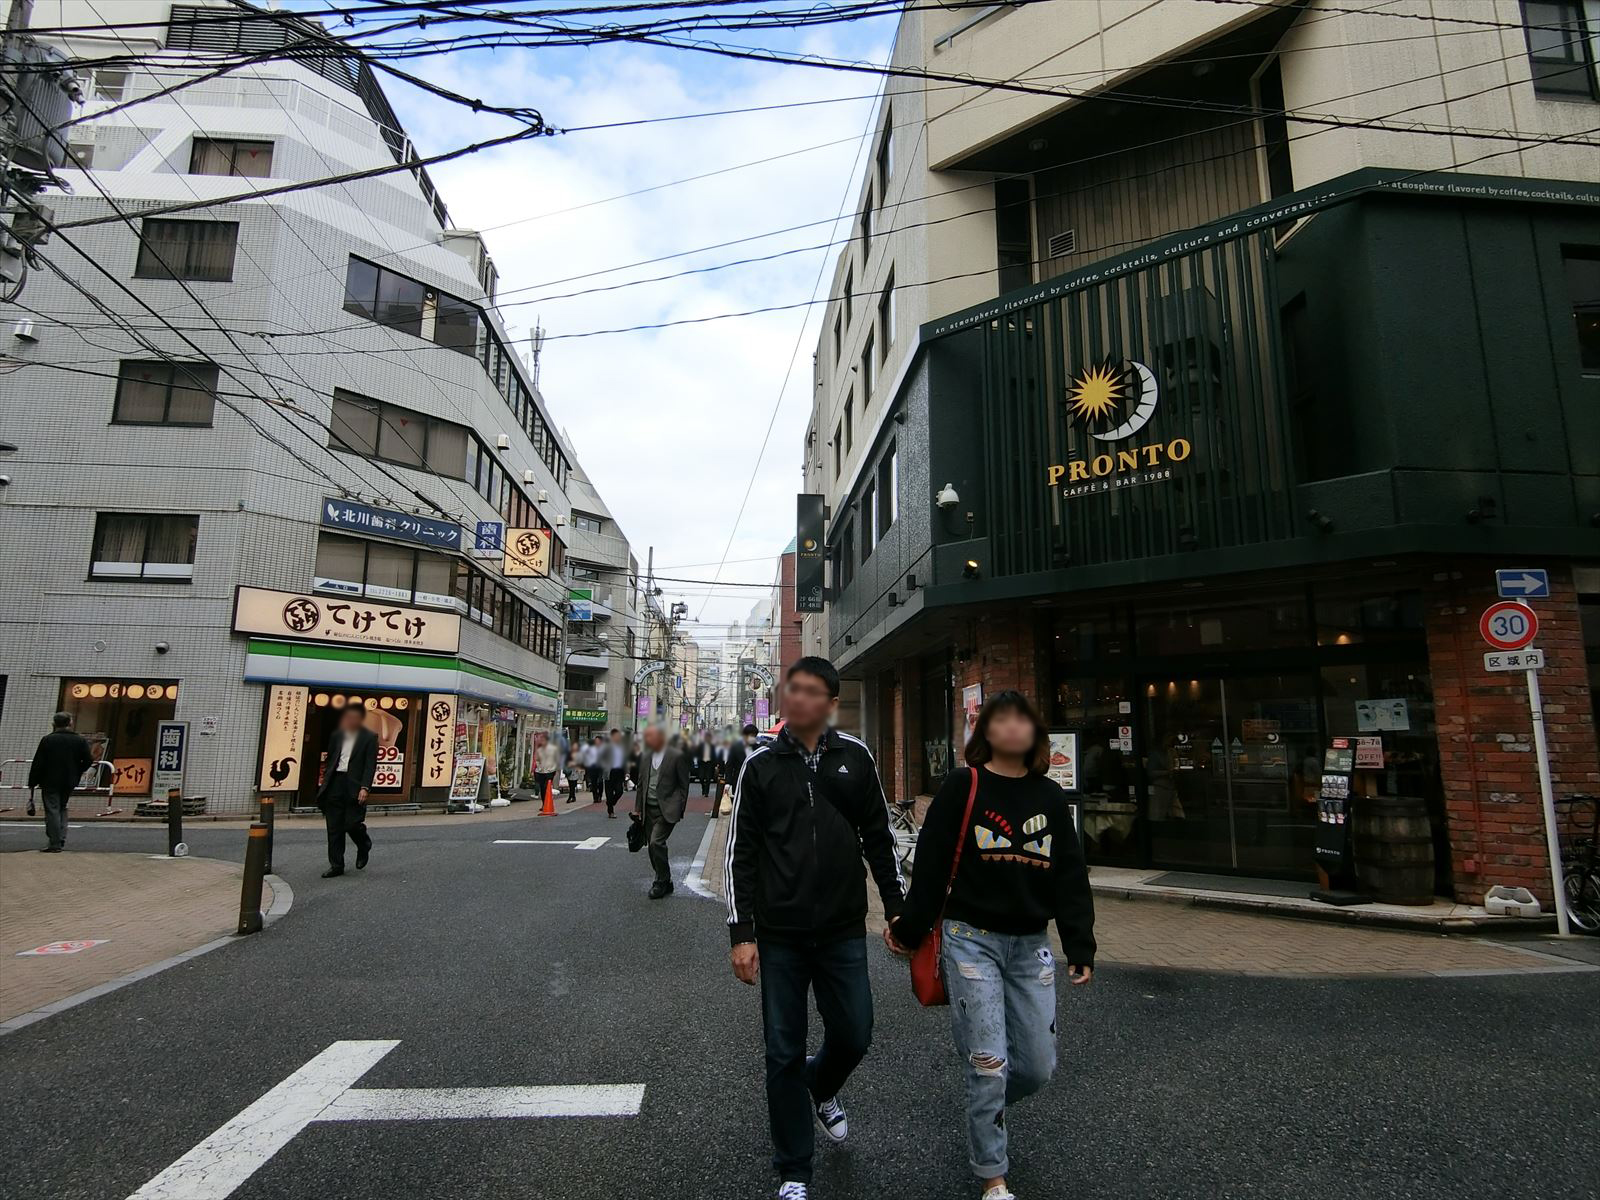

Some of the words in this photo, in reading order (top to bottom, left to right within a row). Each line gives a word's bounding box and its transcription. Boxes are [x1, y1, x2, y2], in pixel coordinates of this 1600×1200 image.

[1391, 181, 1444, 191] atmosphere
[1447, 184, 1486, 194] flavored
[1488, 187, 1499, 196] by
[935, 327, 946, 335] An
[949, 308, 999, 330] atmosphere
[1003, 291, 1045, 310] flavored
[1050, 286, 1061, 296] by
[1164, 234, 1210, 255] culture
[1217, 224, 1239, 238] and
[1048, 438, 1191, 486] PRONTO
[1102, 482, 1109, 490] &
[1116, 477, 1137, 487] BAR
[1144, 470, 1170, 482] 1988
[342, 509, 458, 541] 北川歯科クリニック
[479, 523, 498, 549] 歯科
[326, 603, 426, 639] てけてけ
[1494, 615, 1524, 637] 30
[1489, 655, 1539, 667] 区域内
[160, 729, 181, 769] 歯科
[430, 724, 448, 780] てけてけ
